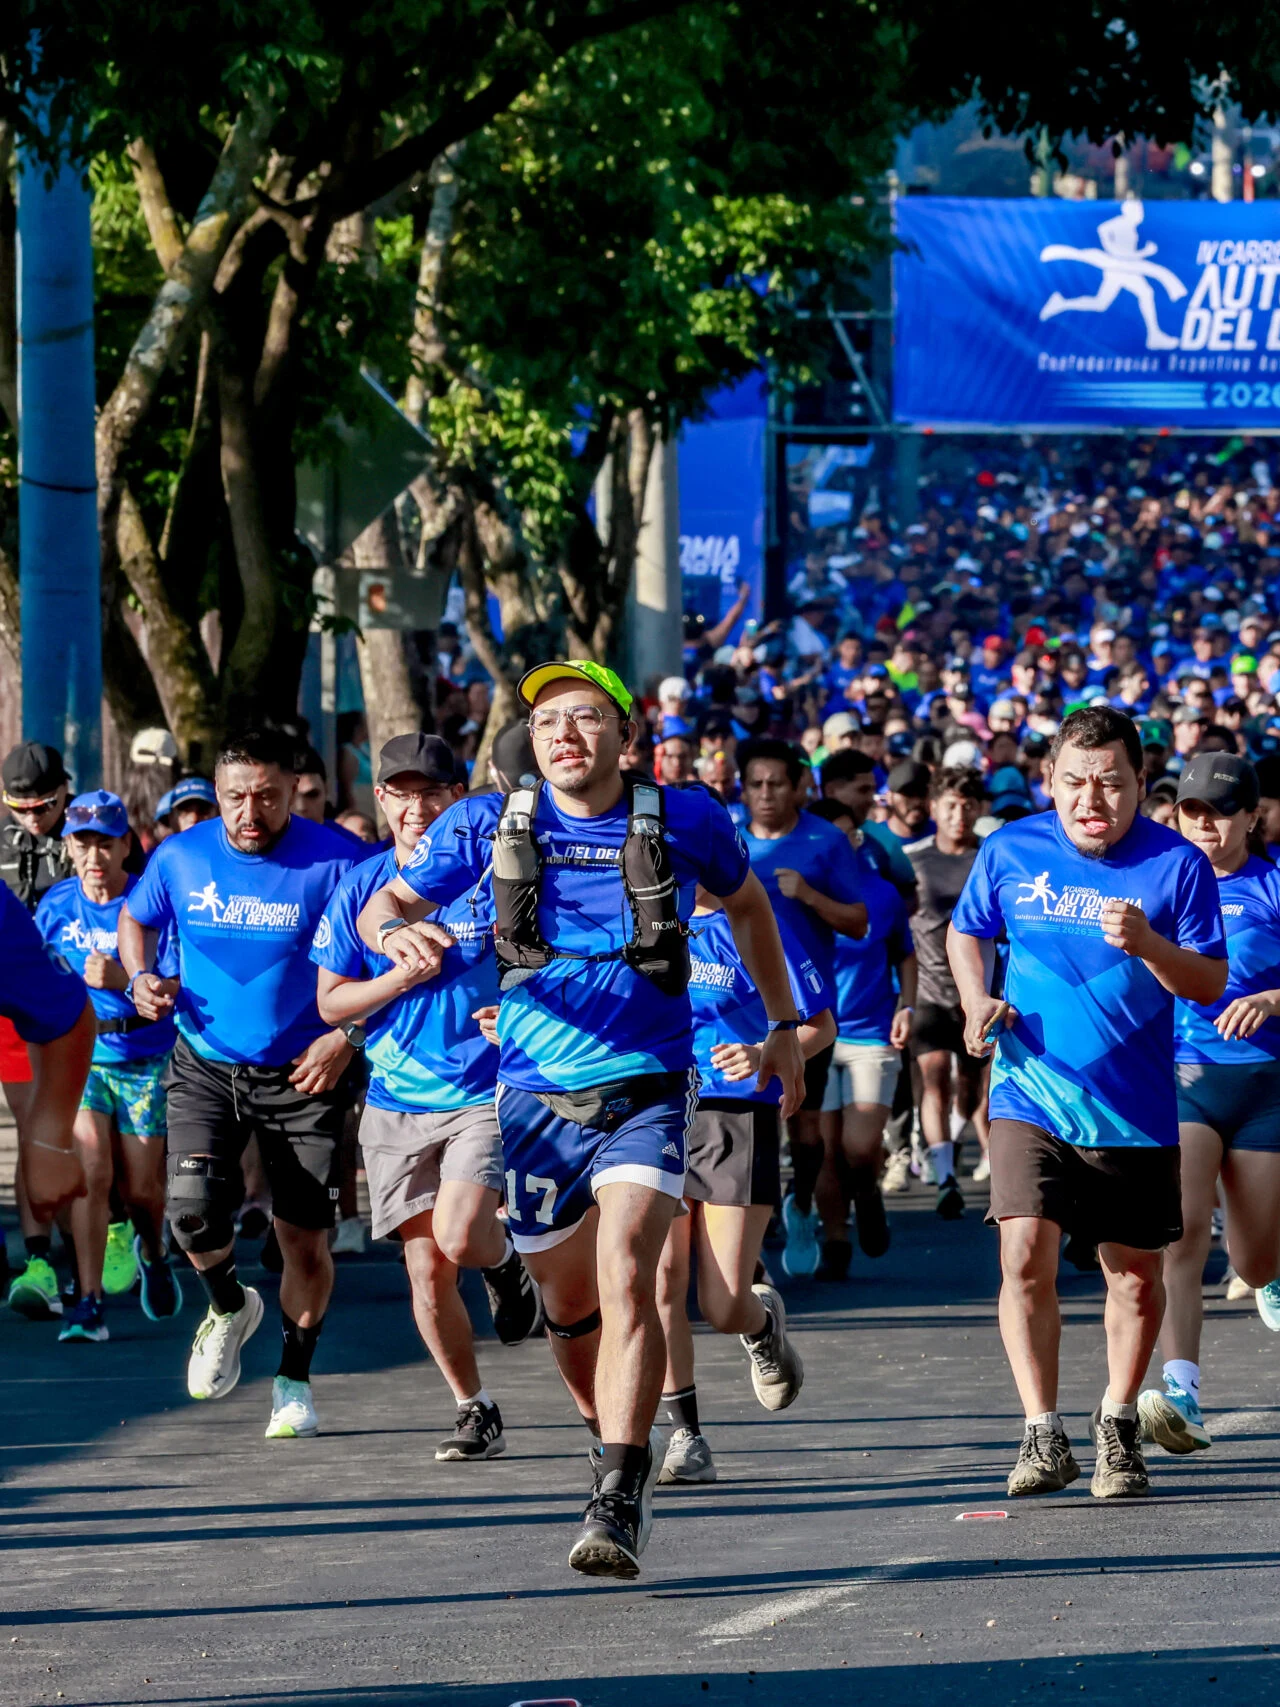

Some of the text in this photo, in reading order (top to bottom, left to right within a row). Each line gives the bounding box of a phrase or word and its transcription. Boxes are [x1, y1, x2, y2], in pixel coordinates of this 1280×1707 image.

[1196, 240, 1220, 265] IV
[1180, 308, 1257, 351] DEL
[565, 846, 591, 859] DEL
[1067, 886, 1099, 896] CARRERA
[233, 895, 261, 903] CARRERA
[1058, 892, 1142, 909] AUTONIA
[225, 901, 300, 917] AUTONOMIA
[1054, 903, 1077, 917] DEL
[222, 912, 299, 926] DEL DEPORTE
[1062, 926, 1087, 935] 2026
[690, 960, 735, 978] ONOMIA
[505, 1168, 559, 1226] 17
